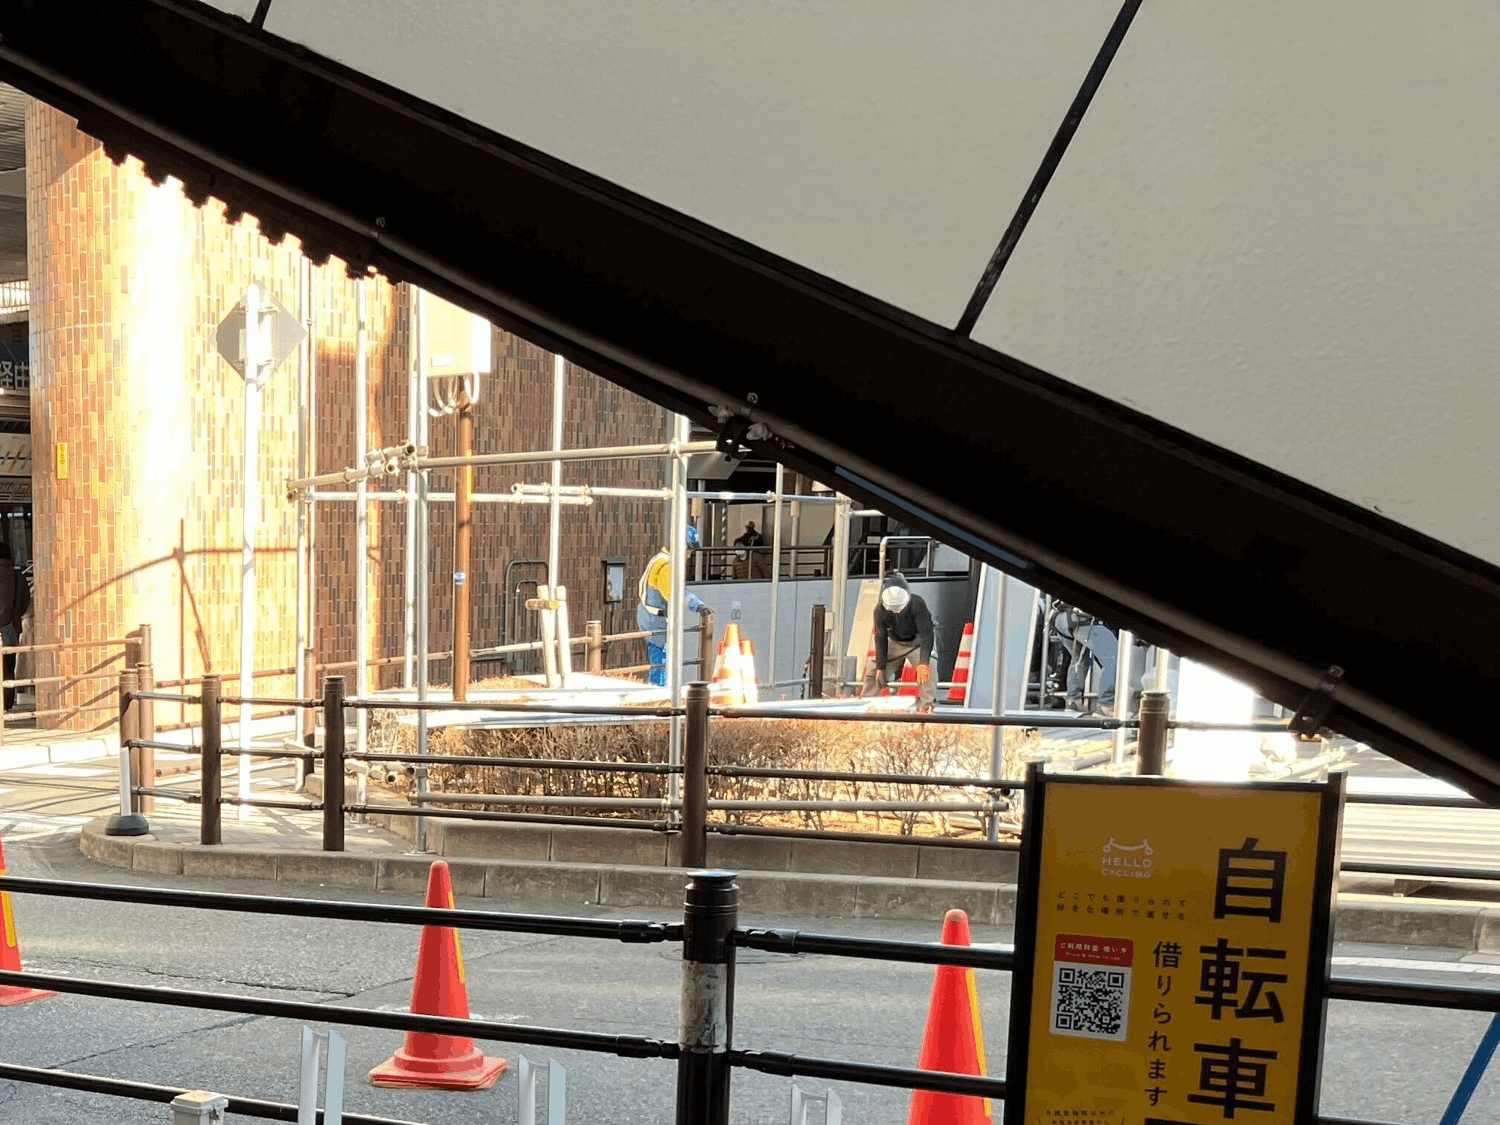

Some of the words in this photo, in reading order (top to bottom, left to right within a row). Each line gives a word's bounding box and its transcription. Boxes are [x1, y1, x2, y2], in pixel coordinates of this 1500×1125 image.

[1102, 856, 1152, 868] HELLO
[1101, 868, 1151, 879] CYCLING
[1058, 890, 1186, 907] どこでも借りられて
[1056, 903, 1185, 921] 好きな場所で返せる
[1187, 837, 1287, 1119] 自転車
[1144, 940, 1182, 1107] 借りられます
